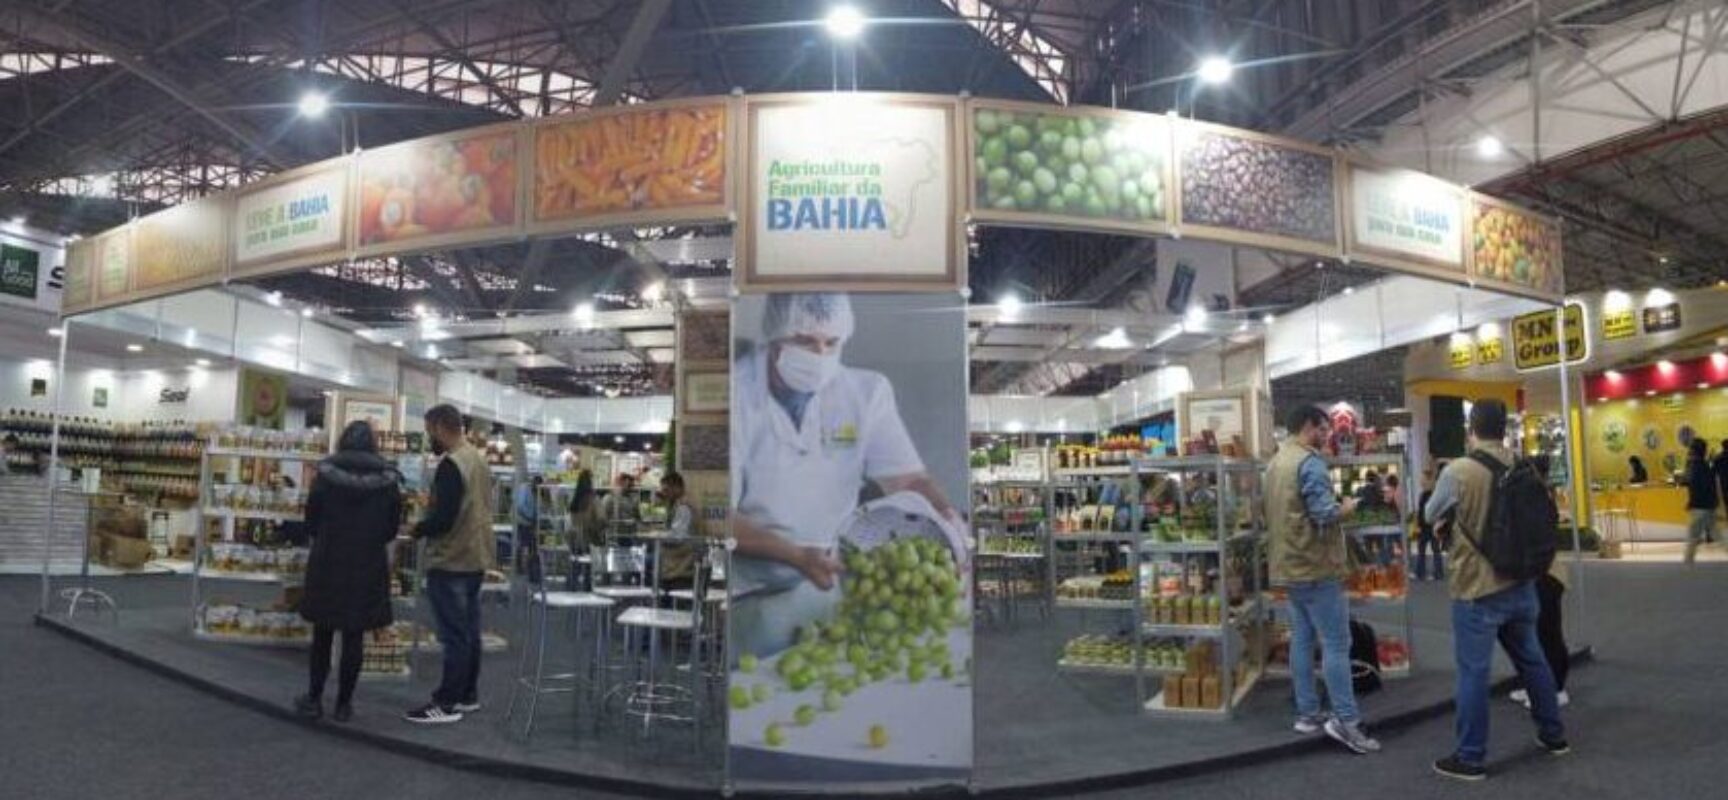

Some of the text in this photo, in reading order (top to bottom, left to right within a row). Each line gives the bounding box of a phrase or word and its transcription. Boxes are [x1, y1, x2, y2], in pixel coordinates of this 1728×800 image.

[768, 159, 882, 178] Agricultura
[768, 178, 882, 196] Familiar da
[289, 194, 329, 220] BAHIA
[766, 197, 887, 231] BAHIA
[1414, 206, 1449, 232] BAHIA
[1518, 316, 1555, 342] MN
